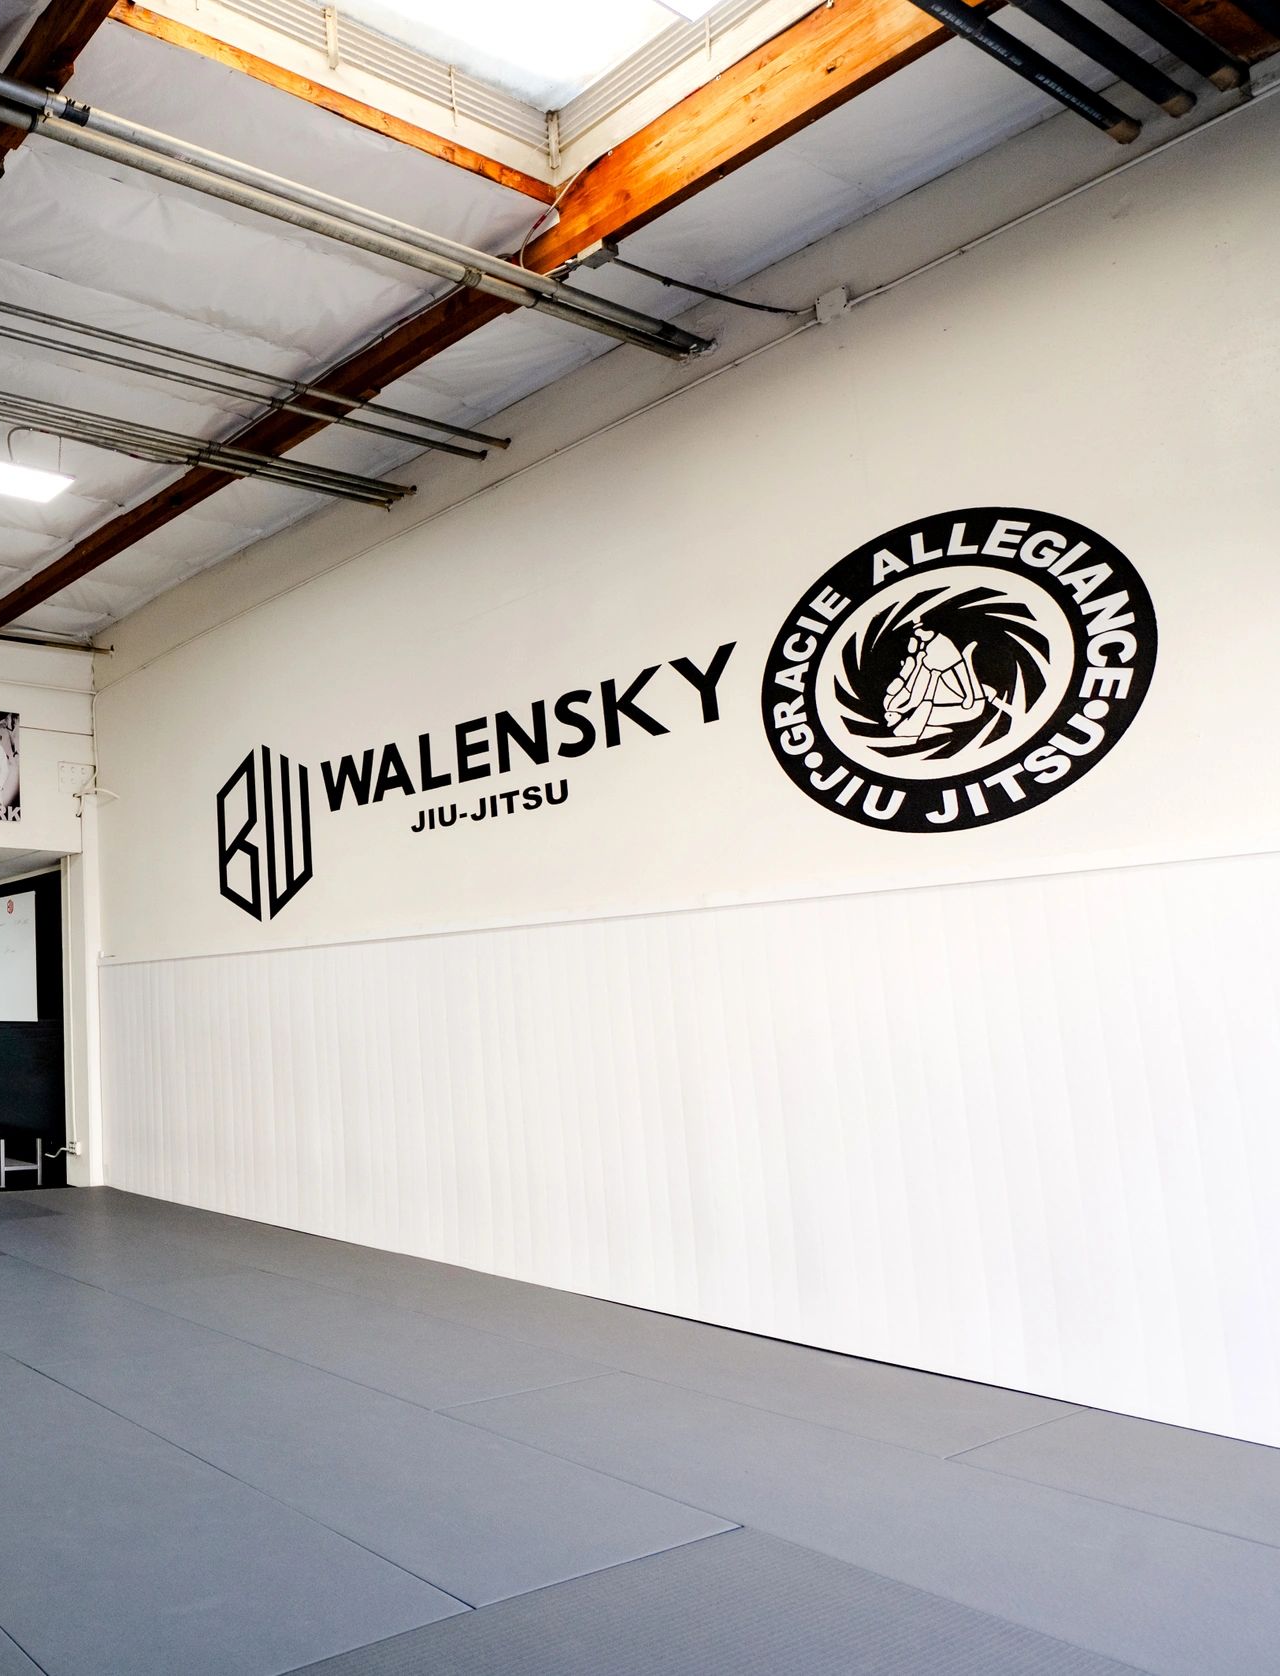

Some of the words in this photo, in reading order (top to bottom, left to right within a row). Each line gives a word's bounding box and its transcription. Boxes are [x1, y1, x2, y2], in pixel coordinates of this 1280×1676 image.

[773, 585, 851, 756] GRACIE
[872, 519, 1138, 699] ALLEGIANCE
[320, 641, 737, 812] WALENSKY
[410, 779, 569, 833] JIU-JITSU
[809, 765, 907, 820] JIU
[925, 711, 1106, 824] JITSU
